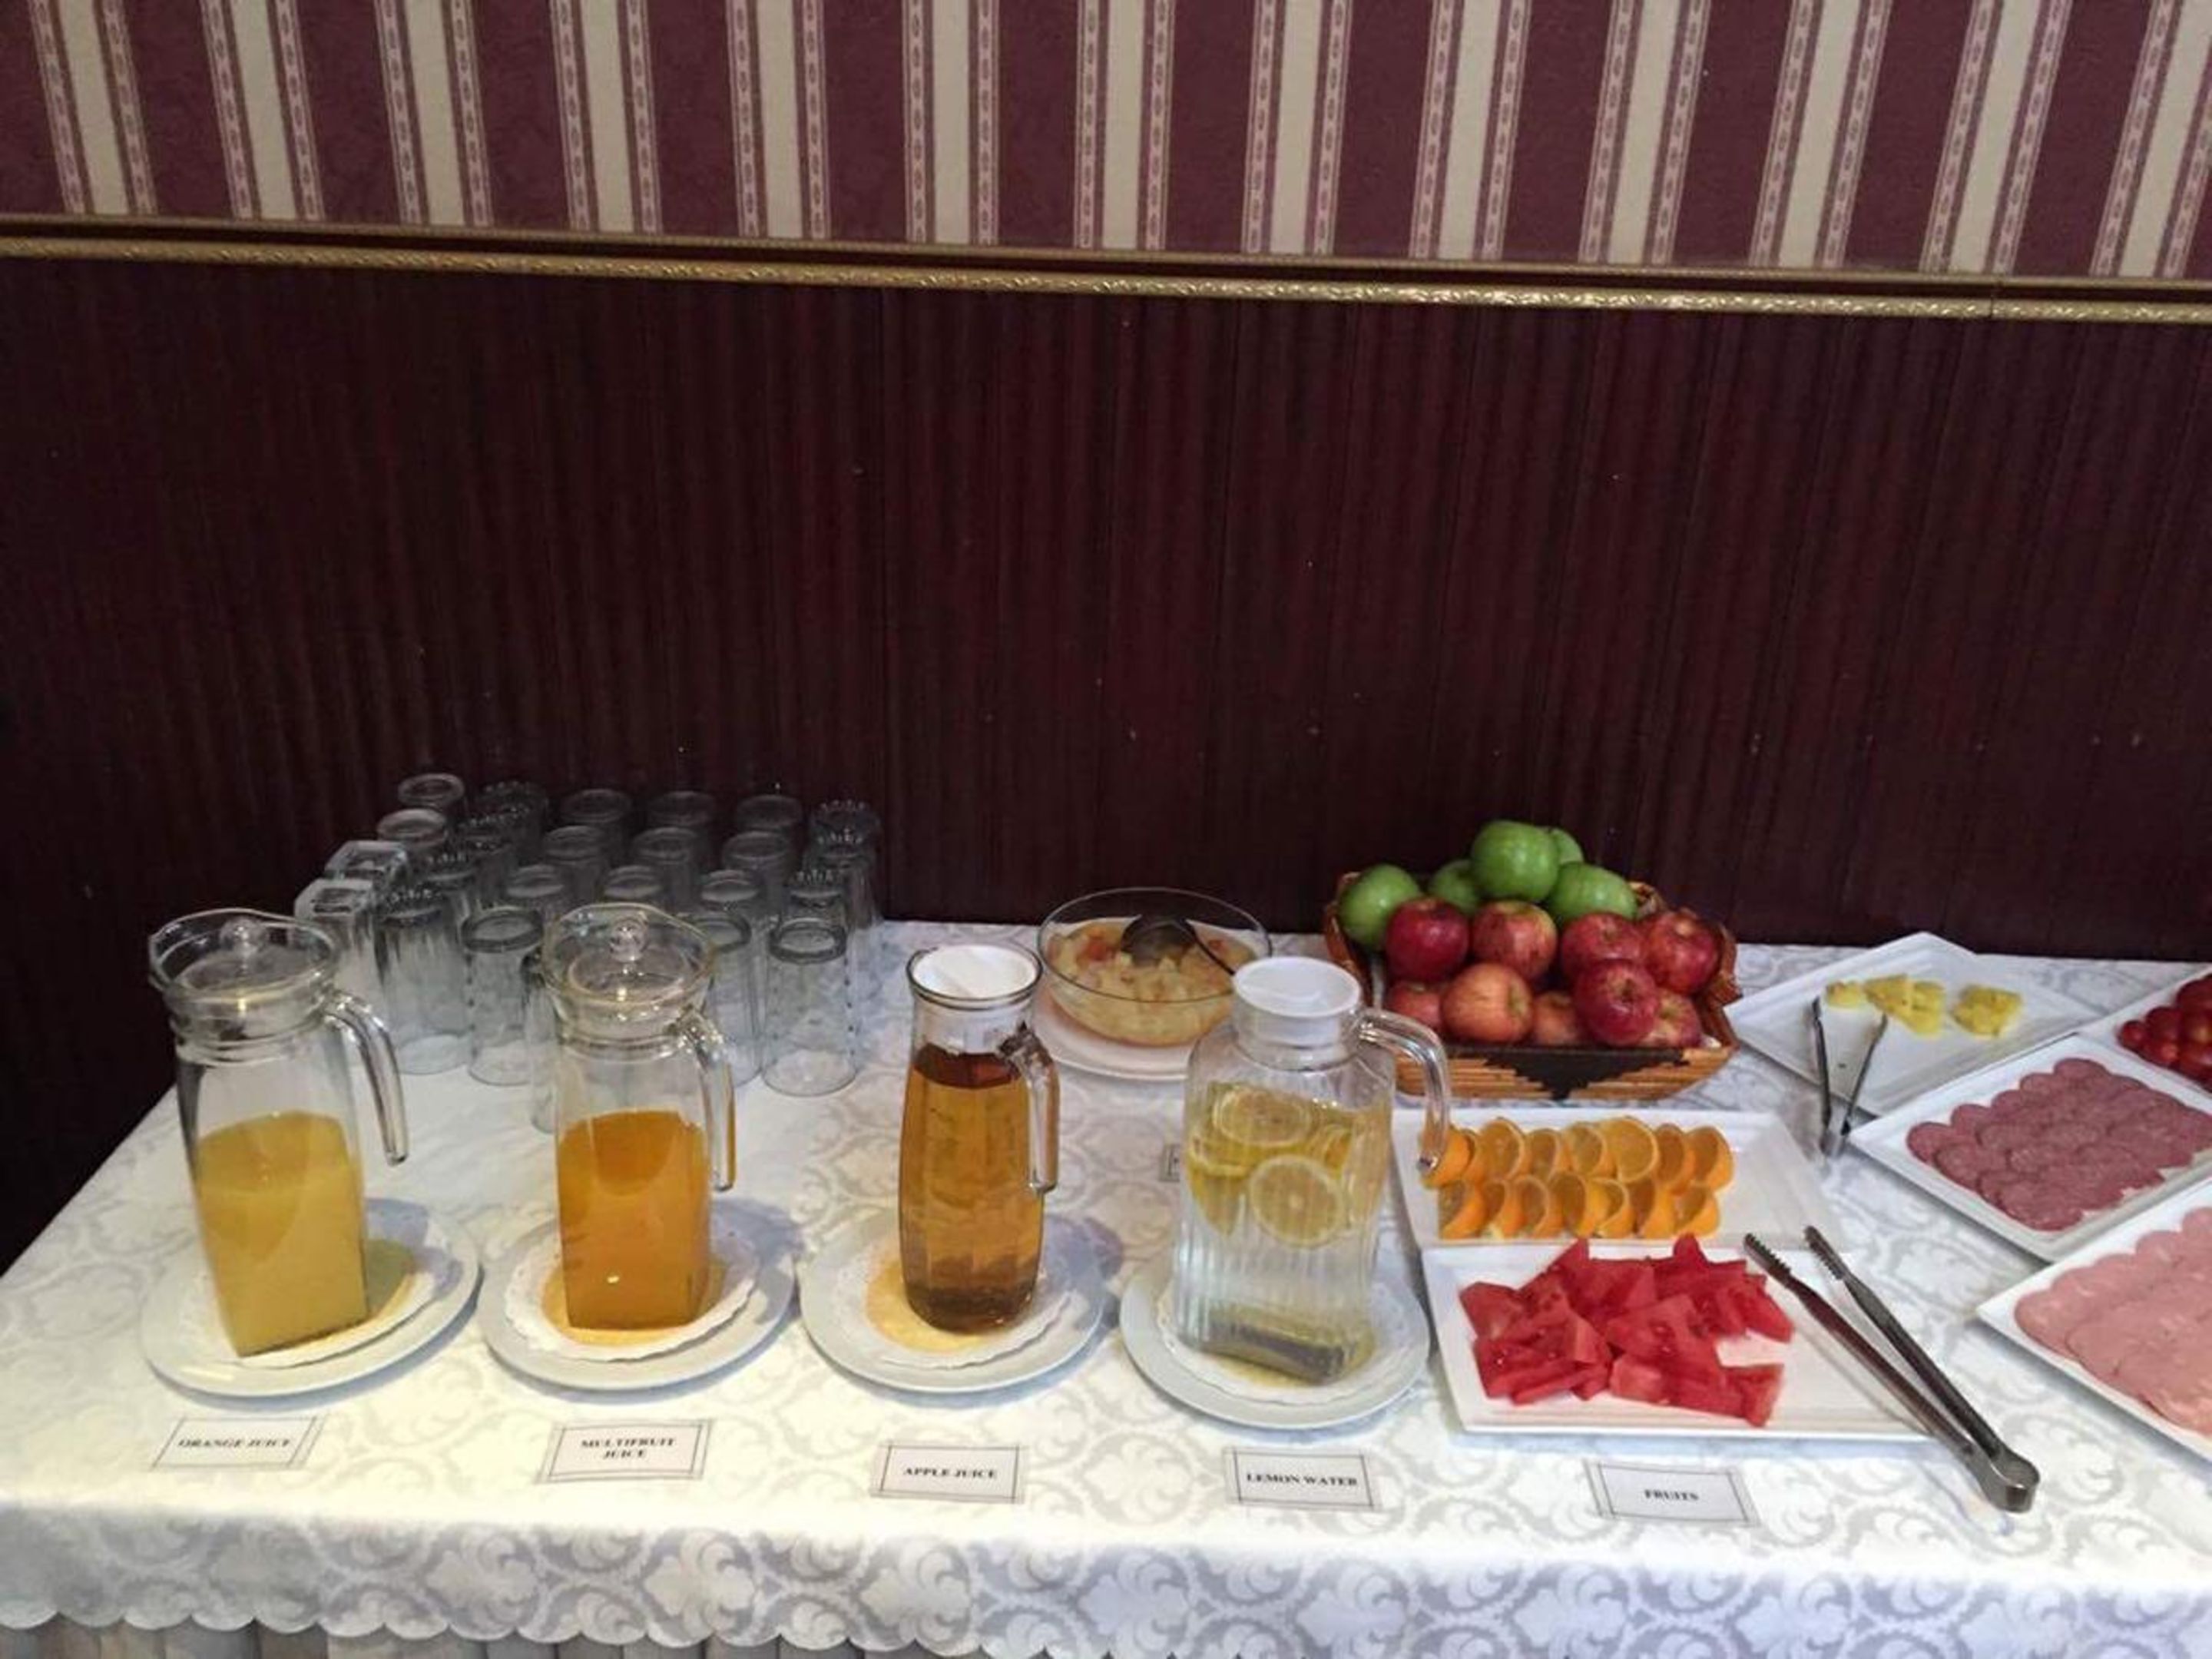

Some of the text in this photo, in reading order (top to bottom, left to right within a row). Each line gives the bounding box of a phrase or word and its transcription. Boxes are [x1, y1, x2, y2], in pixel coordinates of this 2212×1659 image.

[177, 1438, 290, 1448] ORANGE JUICE
[581, 1437, 674, 1449] MULTIFRUIT
[603, 1449, 647, 1459] JUICE
[902, 1466, 998, 1479] APPLE JUICE
[1246, 1472, 1358, 1486] LEMON WATER
[1643, 1488, 1700, 1501] FRUITS
